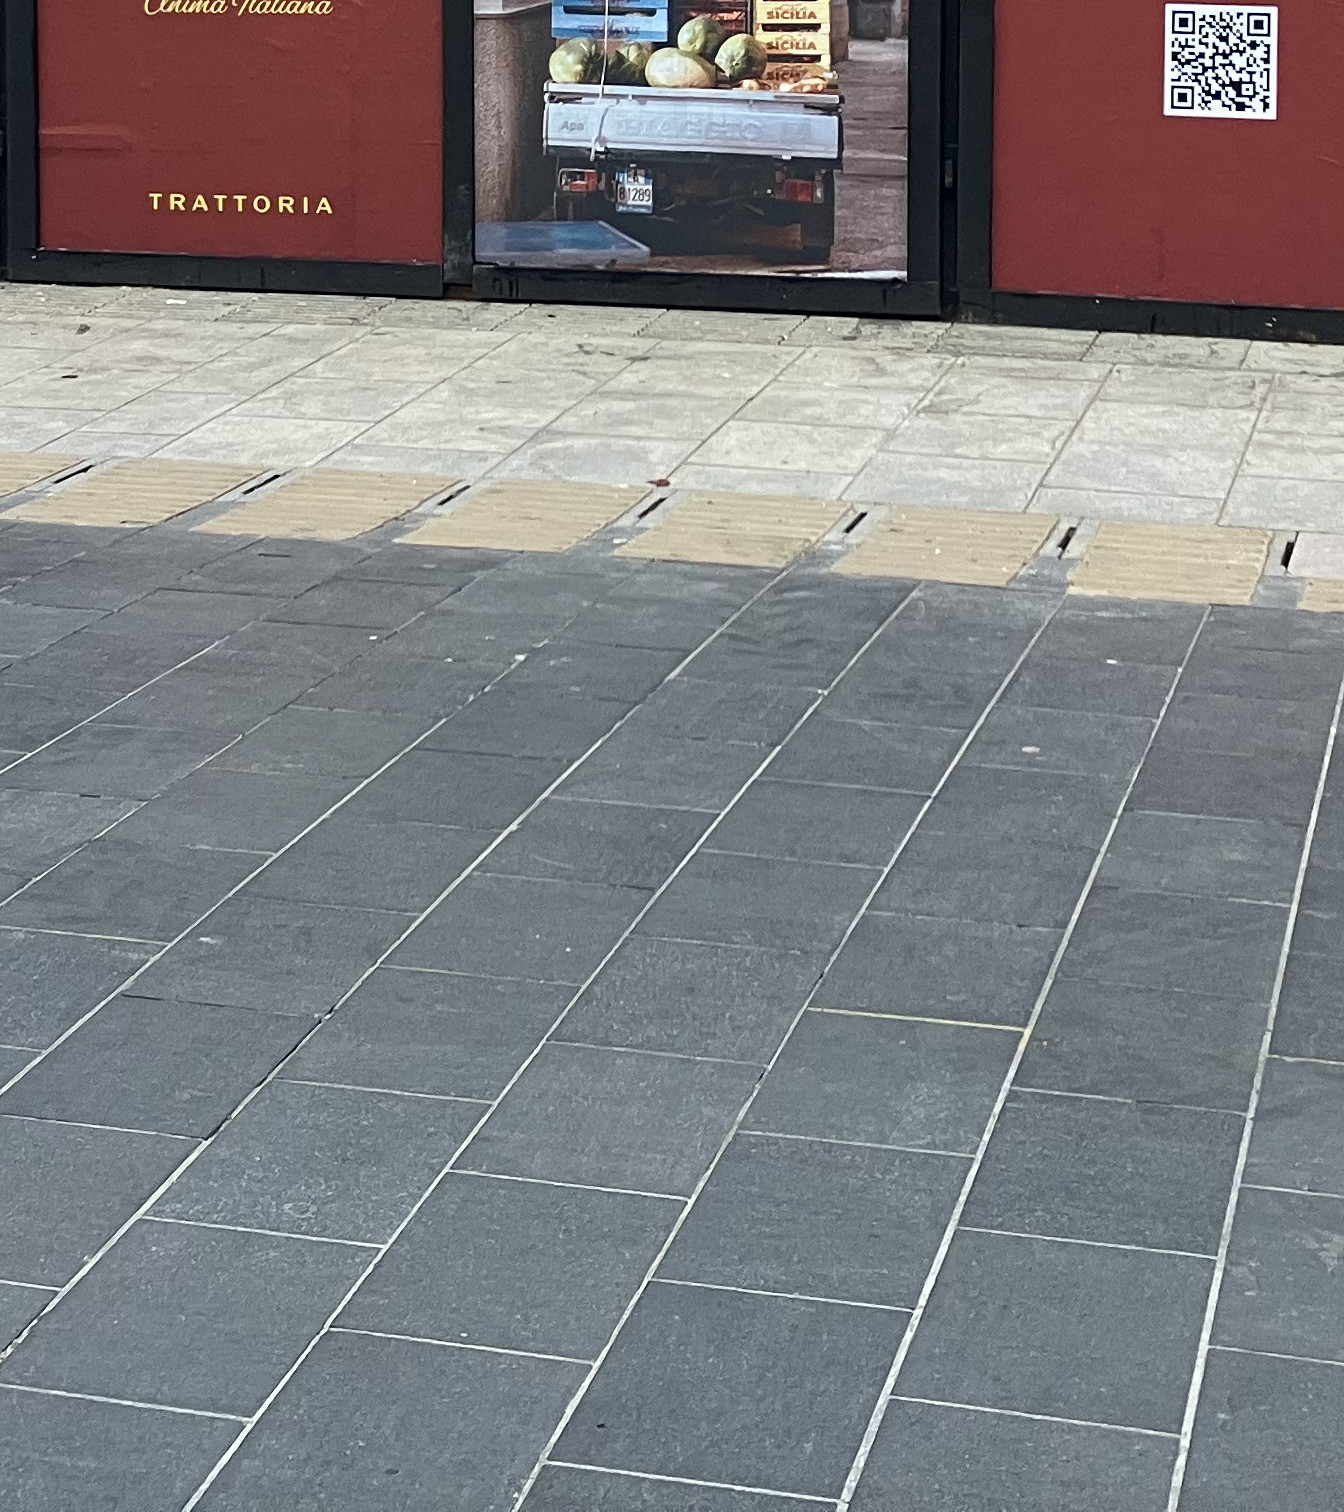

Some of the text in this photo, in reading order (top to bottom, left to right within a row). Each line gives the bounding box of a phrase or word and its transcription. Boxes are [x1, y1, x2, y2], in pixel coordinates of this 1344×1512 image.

[766, 10, 817, 20] SICILIA
[765, 41, 817, 51] SICILIA
[619, 187, 651, 203] 81289
[149, 192, 333, 215] TRATTORIA
